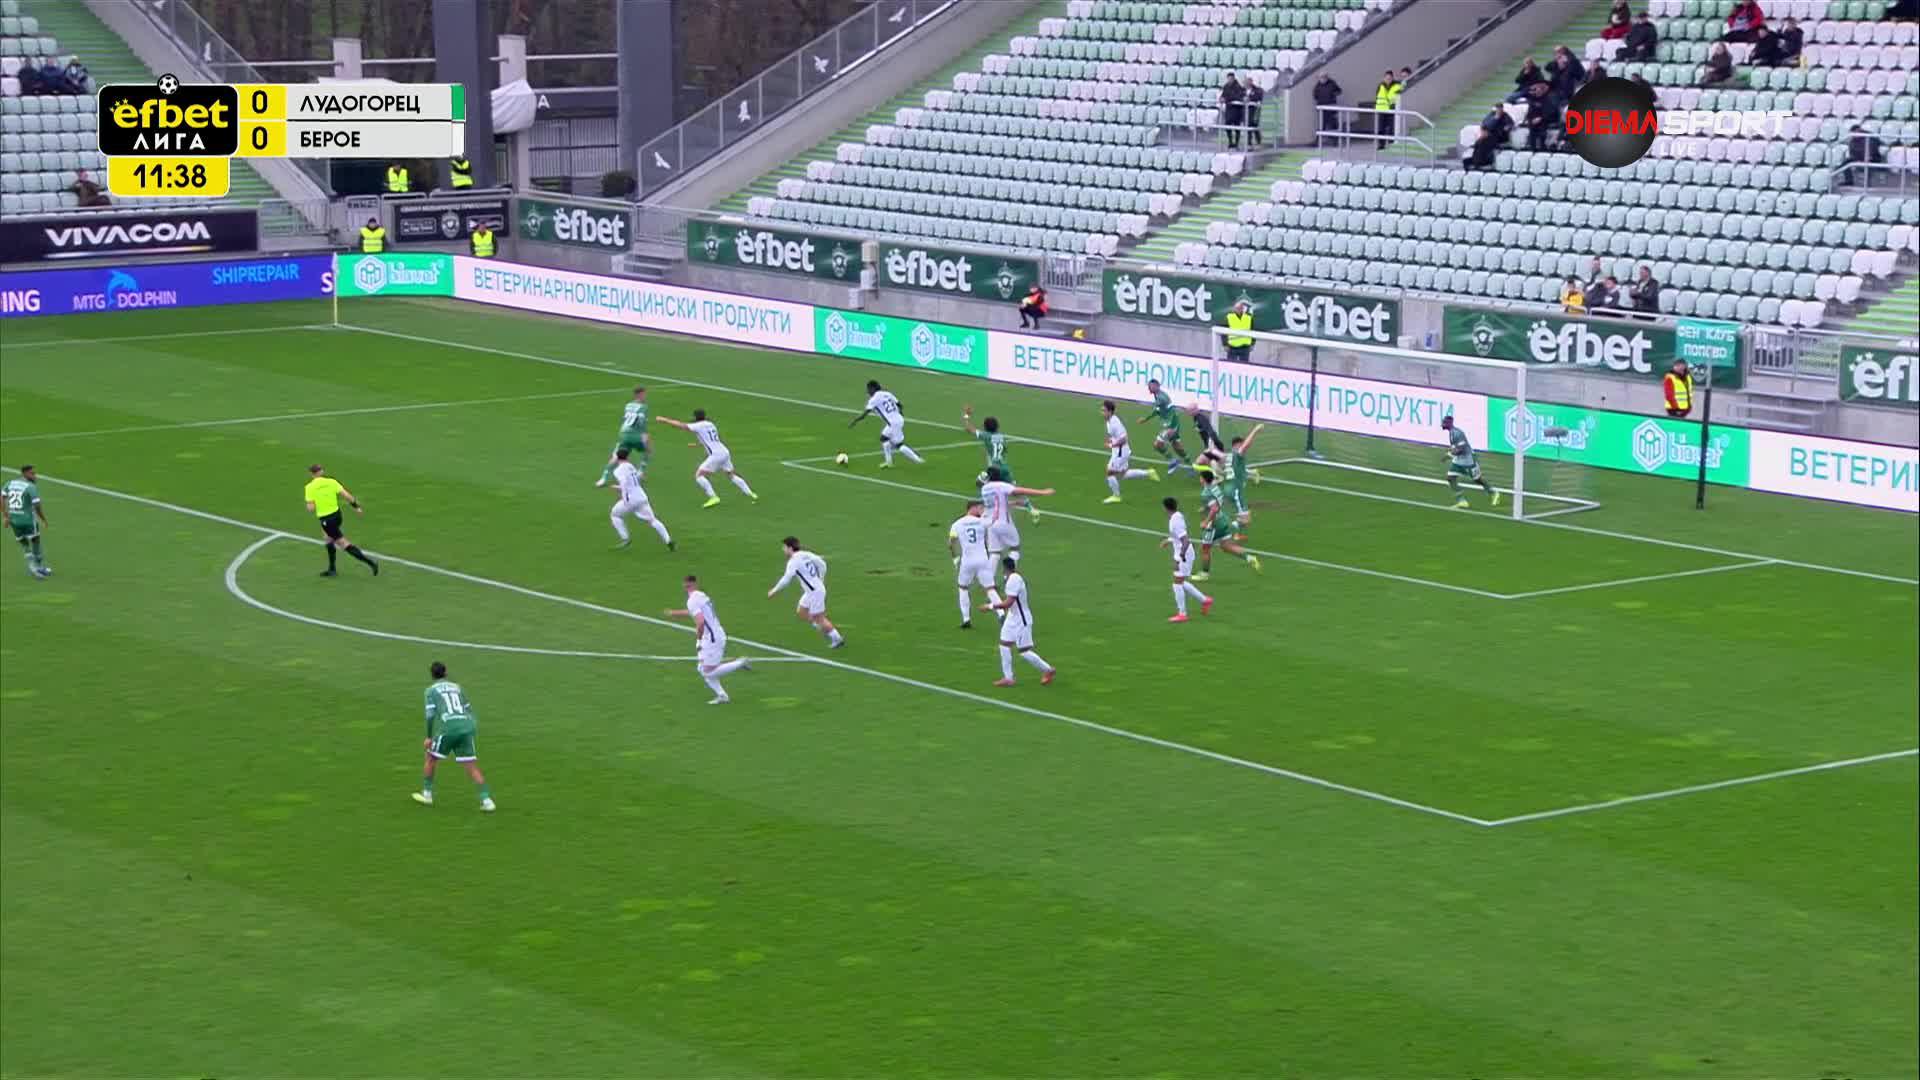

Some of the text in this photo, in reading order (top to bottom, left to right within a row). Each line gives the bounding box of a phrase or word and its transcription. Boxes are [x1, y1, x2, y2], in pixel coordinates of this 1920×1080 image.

[45, 221, 211, 247] VIVACOM
[552, 207, 625, 246] efbet
[734, 229, 816, 273] efbet
[885, 249, 972, 292] efbet
[212, 263, 299, 286] SHIPREPAIR
[321, 271, 333, 293] S
[73, 291, 177, 311] MTG DOLPHIN
[474, 267, 792, 334] ВЕТЕРИНАРНОМЕДИЦИНСКИ ПРОДУКТИ
[1113, 275, 1212, 321] efbet
[1282, 295, 1390, 343] efbet
[1528, 321, 1653, 373] efbet
[1328, 387, 1454, 427] ПРОДУКТИ
[966, 528, 976, 543] 3
[441, 693, 463, 714] 14
